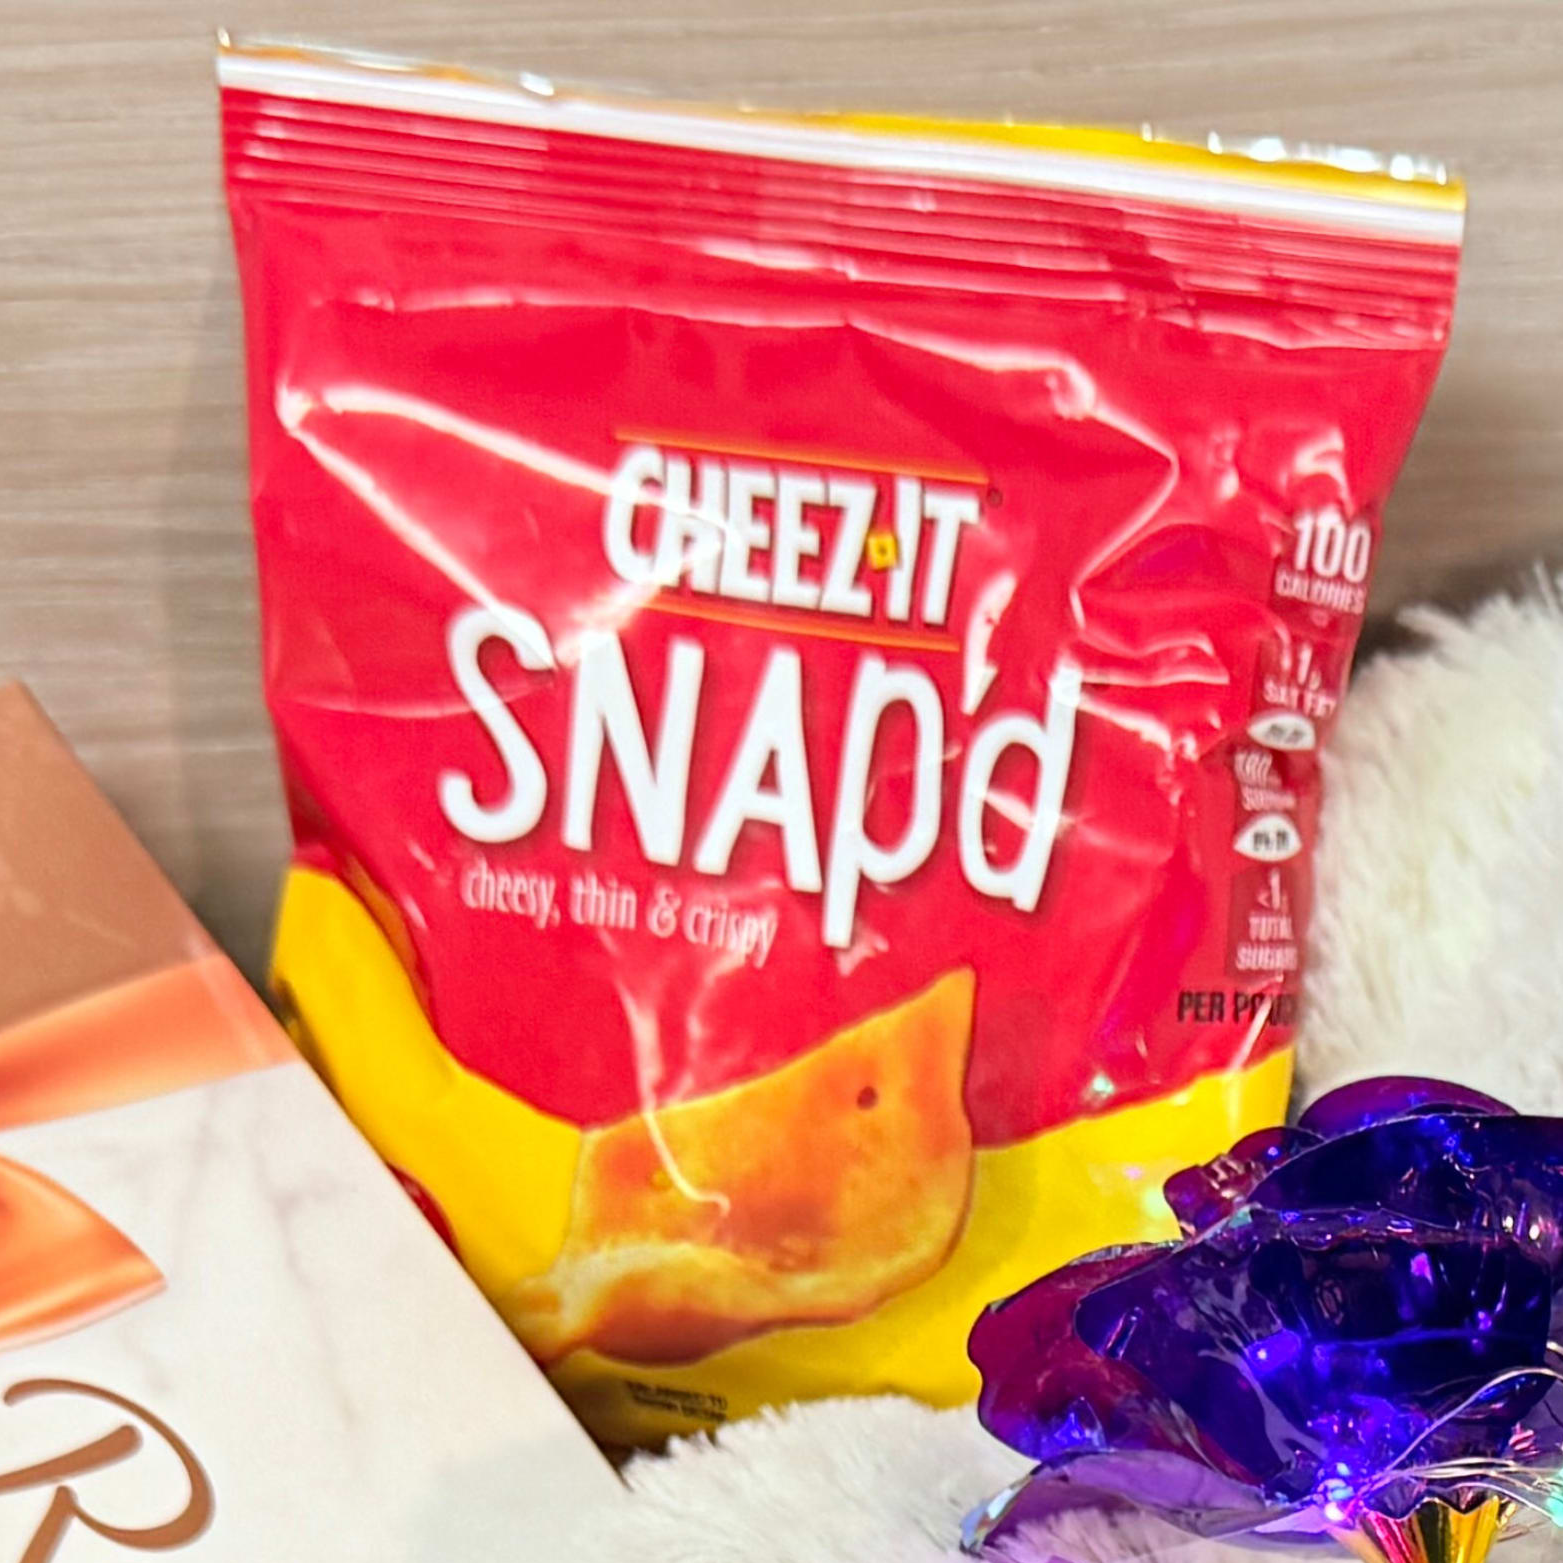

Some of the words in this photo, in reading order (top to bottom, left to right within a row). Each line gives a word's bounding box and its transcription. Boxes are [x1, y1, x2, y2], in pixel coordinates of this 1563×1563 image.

[1294, 505, 1372, 583] 100
[460, 851, 561, 929] cheesy,
[570, 871, 636, 930] thin
[646, 885, 681, 938] &
[682, 899, 779, 969] crispy
[1177, 990, 1225, 1023] PER
